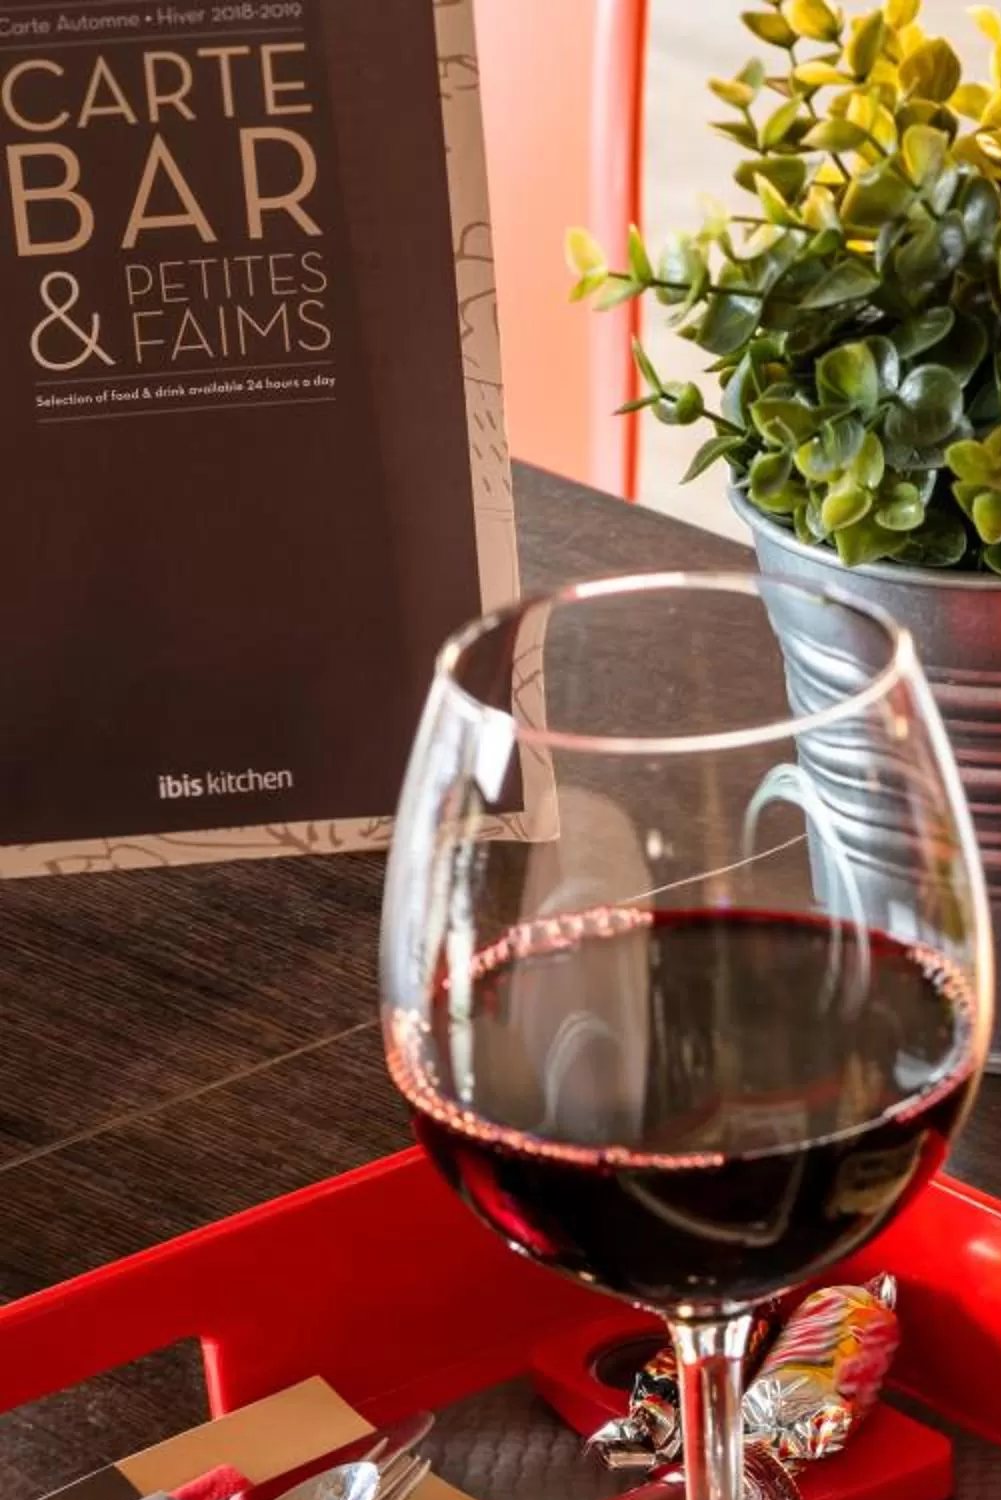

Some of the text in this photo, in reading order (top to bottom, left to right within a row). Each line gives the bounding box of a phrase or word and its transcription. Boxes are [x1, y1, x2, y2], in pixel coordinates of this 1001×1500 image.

[0, 2, 303, 37] Carte Automne Hiver 2018-2019
[1, 42, 313, 132] CARTE
[6, 126, 324, 257] BAR
[125, 251, 328, 305] PETITES
[30, 270, 117, 371] &
[132, 299, 332, 364] FAIMS
[35, 374, 336, 409] Selection of food & drink available 24 hours a day
[158, 768, 293, 799] ibis kitchen
